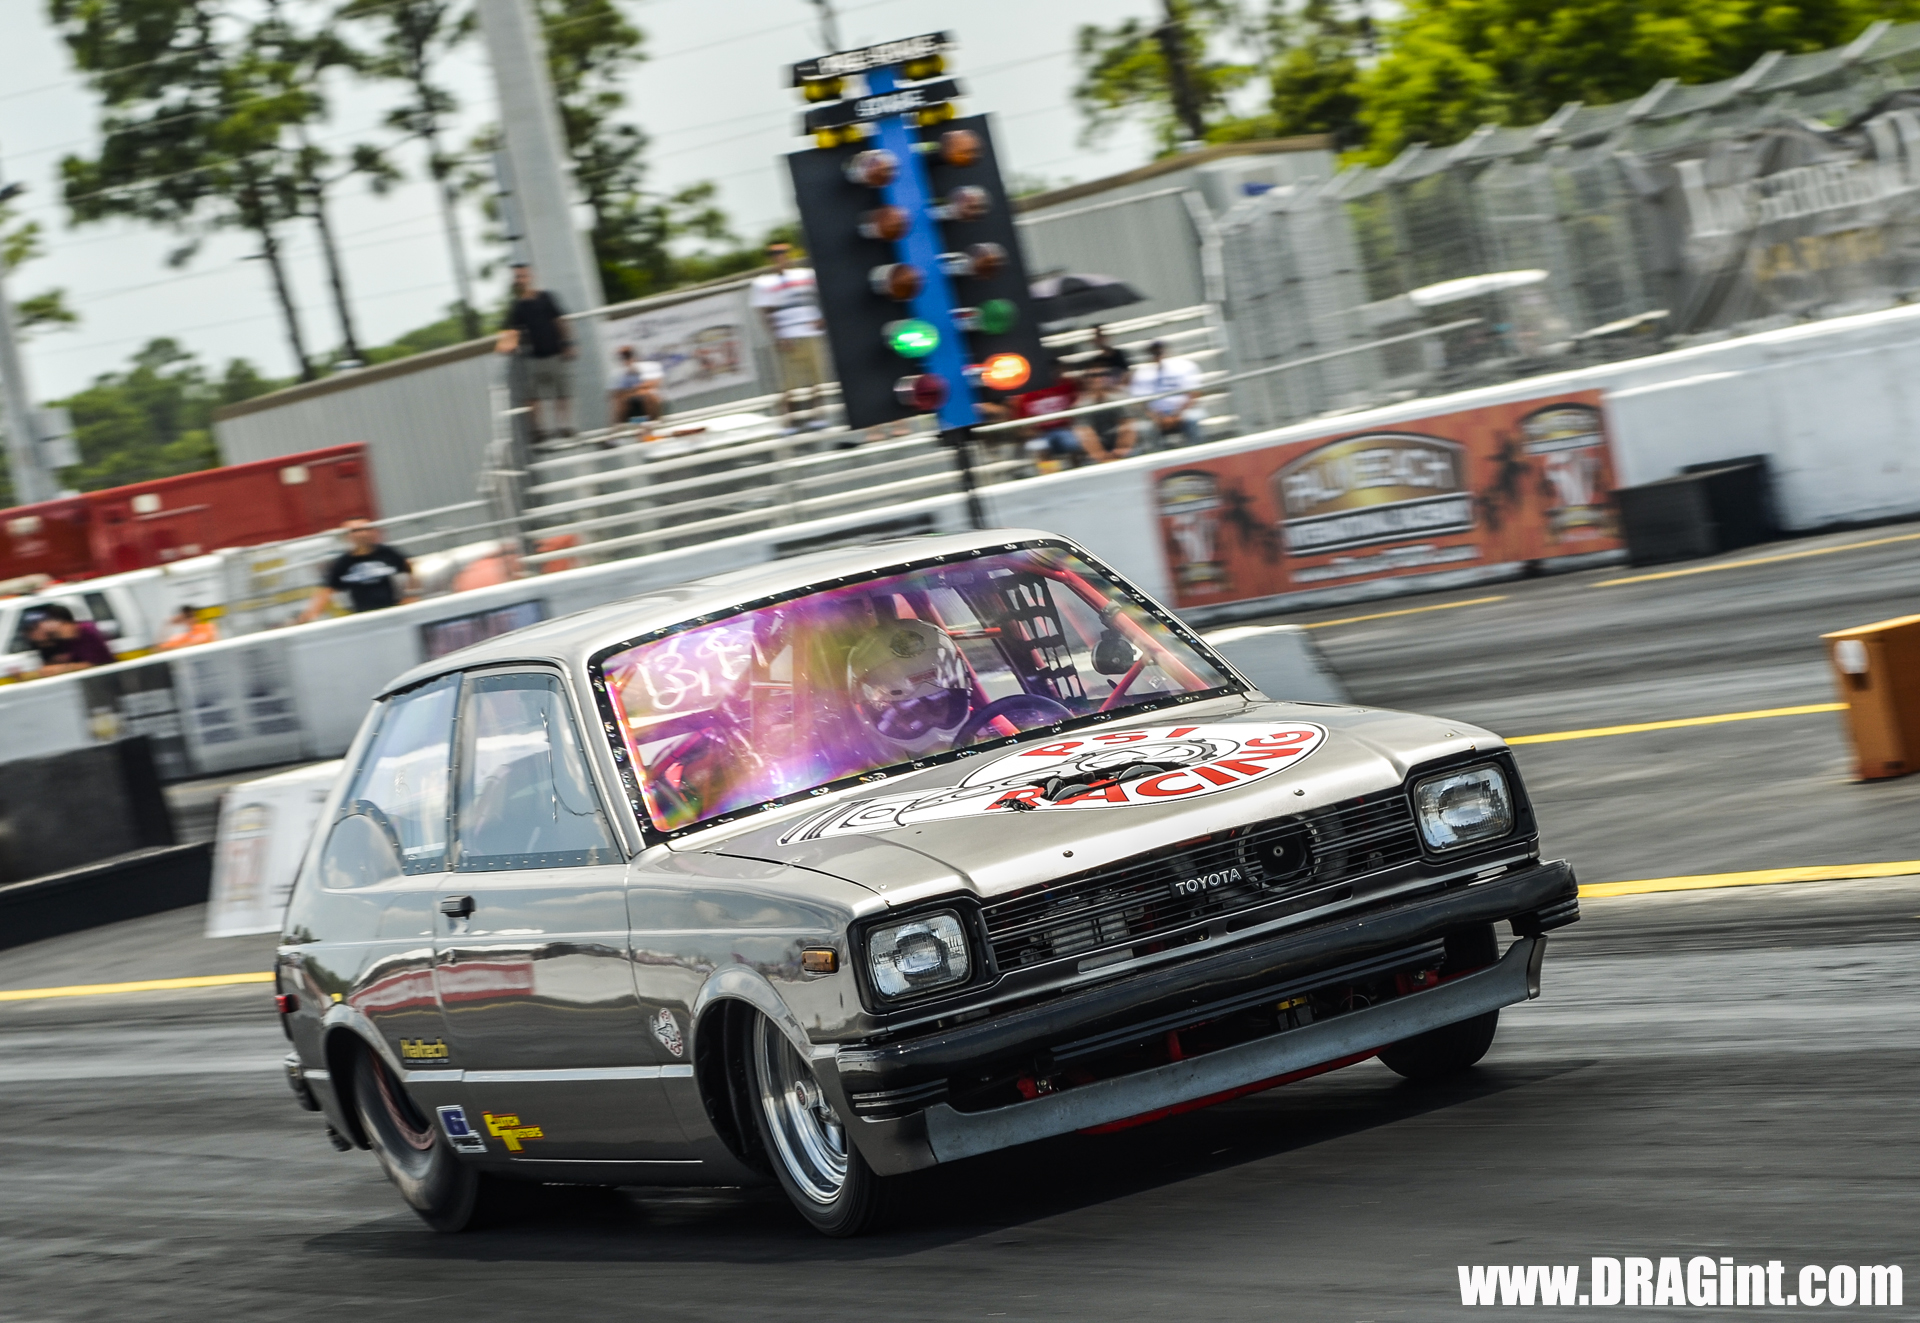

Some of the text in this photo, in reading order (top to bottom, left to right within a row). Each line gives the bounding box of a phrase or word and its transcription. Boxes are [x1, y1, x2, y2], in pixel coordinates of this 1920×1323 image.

[1019, 727, 1200, 757] PSI
[985, 730, 1315, 811] RACING
[1175, 868, 1242, 896] TOYOTA
